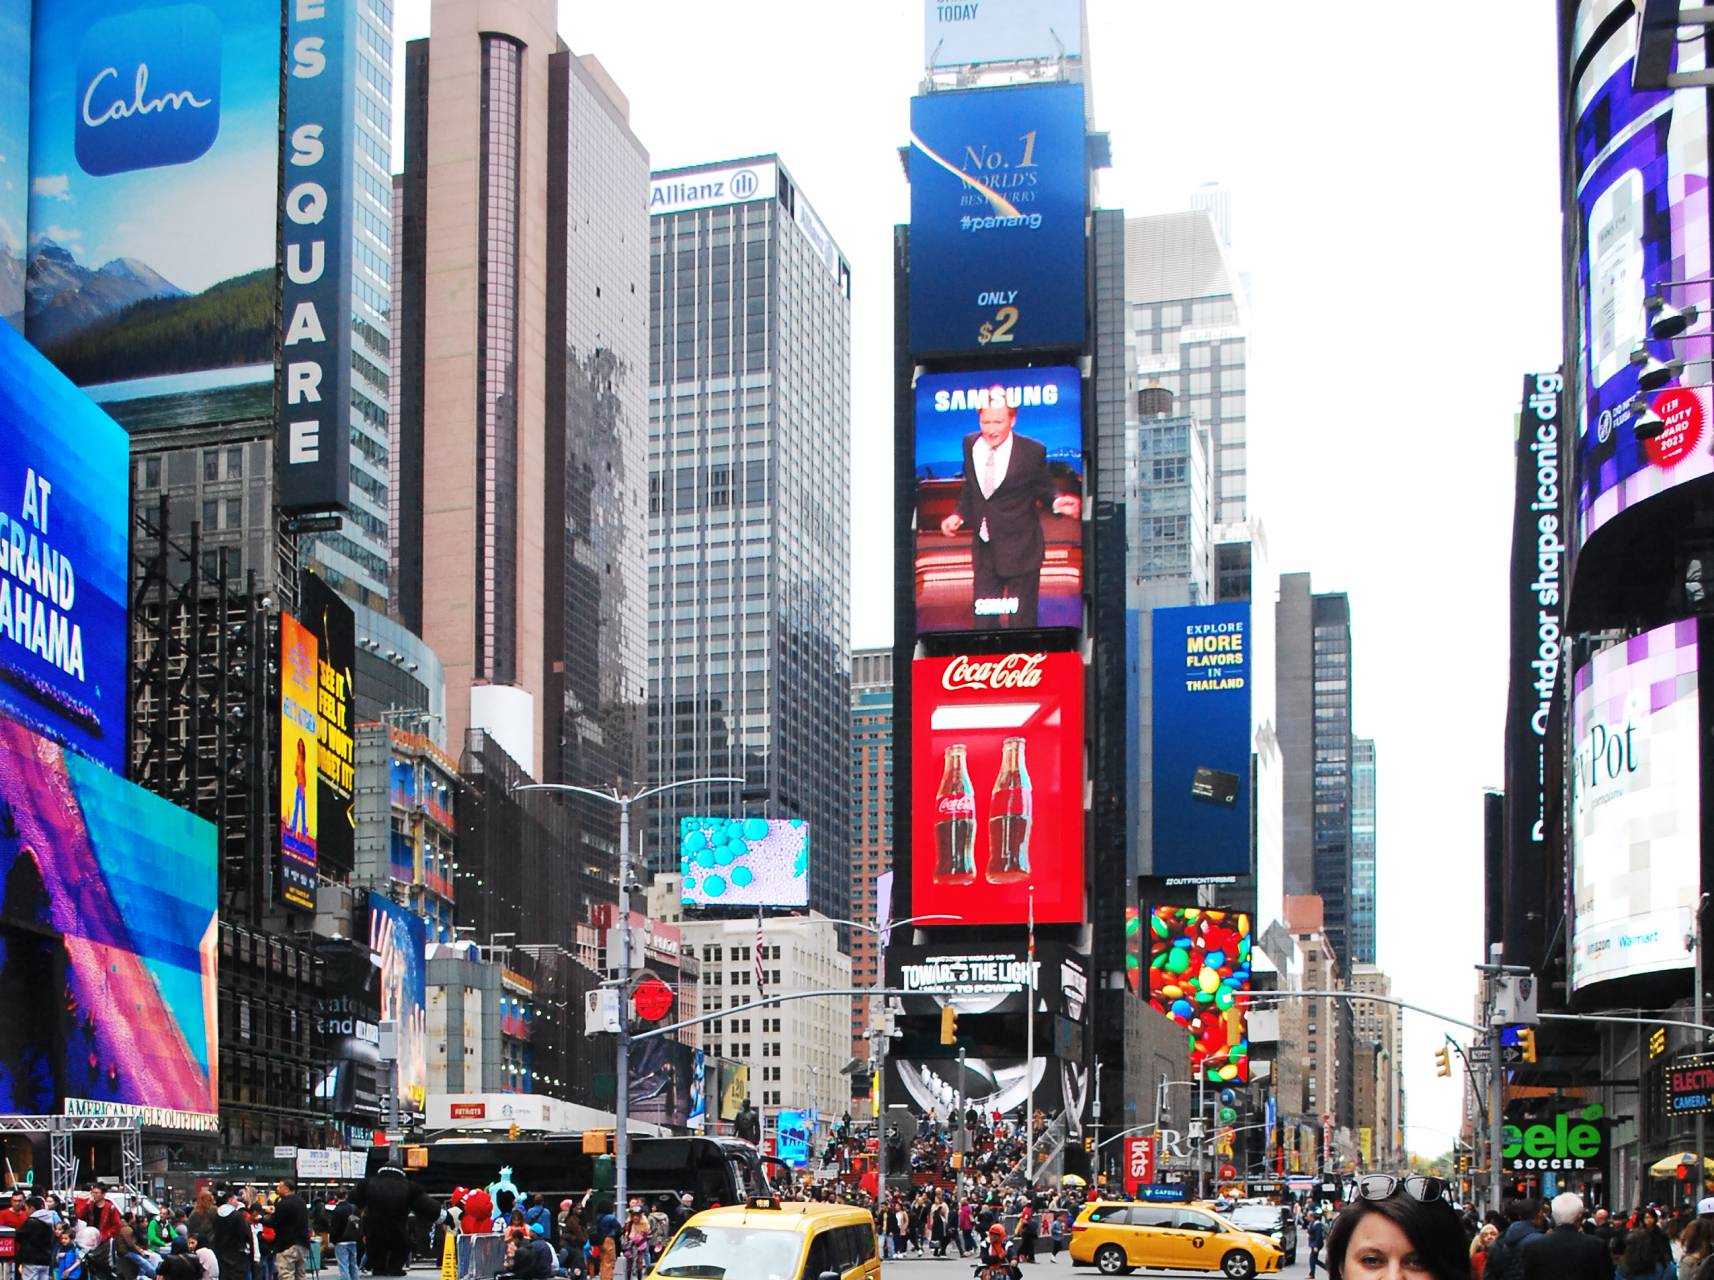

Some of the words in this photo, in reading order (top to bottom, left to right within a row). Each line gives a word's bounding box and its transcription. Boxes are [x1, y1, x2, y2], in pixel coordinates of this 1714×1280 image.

[937, 4, 978, 23] TODAY
[83, 63, 212, 128] Calm
[961, 144, 1009, 171] No.
[1014, 129, 1039, 169] 1
[962, 171, 1038, 190] WORLD'S
[651, 180, 724, 206] Allianz
[1000, 190, 1038, 203] URRY
[959, 213, 1042, 232] #panang
[284, 124, 328, 465] SQUARE
[977, 290, 1018, 306] ONLY
[977, 306, 1019, 346] $2
[934, 383, 1059, 413] SAMSUNG
[1662, 407, 1692, 427] AUTY
[1655, 421, 1689, 443] WARD
[1531, 424, 1560, 511] iconic
[21, 467, 52, 536] AT
[0, 511, 75, 612] GRAND
[1531, 513, 1566, 607] shape
[1186, 621, 1244, 635] EXPLORE
[1186, 633, 1243, 653] MORE
[1186, 652, 1244, 668] FLAVORS
[941, 652, 1048, 691] Coca-Cola
[1207, 666, 1222, 678] IN
[1185, 677, 1245, 692] THAILAND
[1618, 930, 1658, 949] Walmart
[901, 963, 969, 993] TOWARS
[969, 962, 998, 983] THE
[998, 960, 1041, 991] LIGHT
[974, 983, 1023, 993] POWER
[1674, 1095, 1707, 1110] CAMERA
[67, 1100, 128, 1117] AMERICAN
[163, 1109, 219, 1132] OUTFITTERS
[1131, 1139, 1150, 1178] tkts
[1513, 1158, 1585, 1170] SOCCER
[1154, 1189, 1184, 1197] CAPSULE
